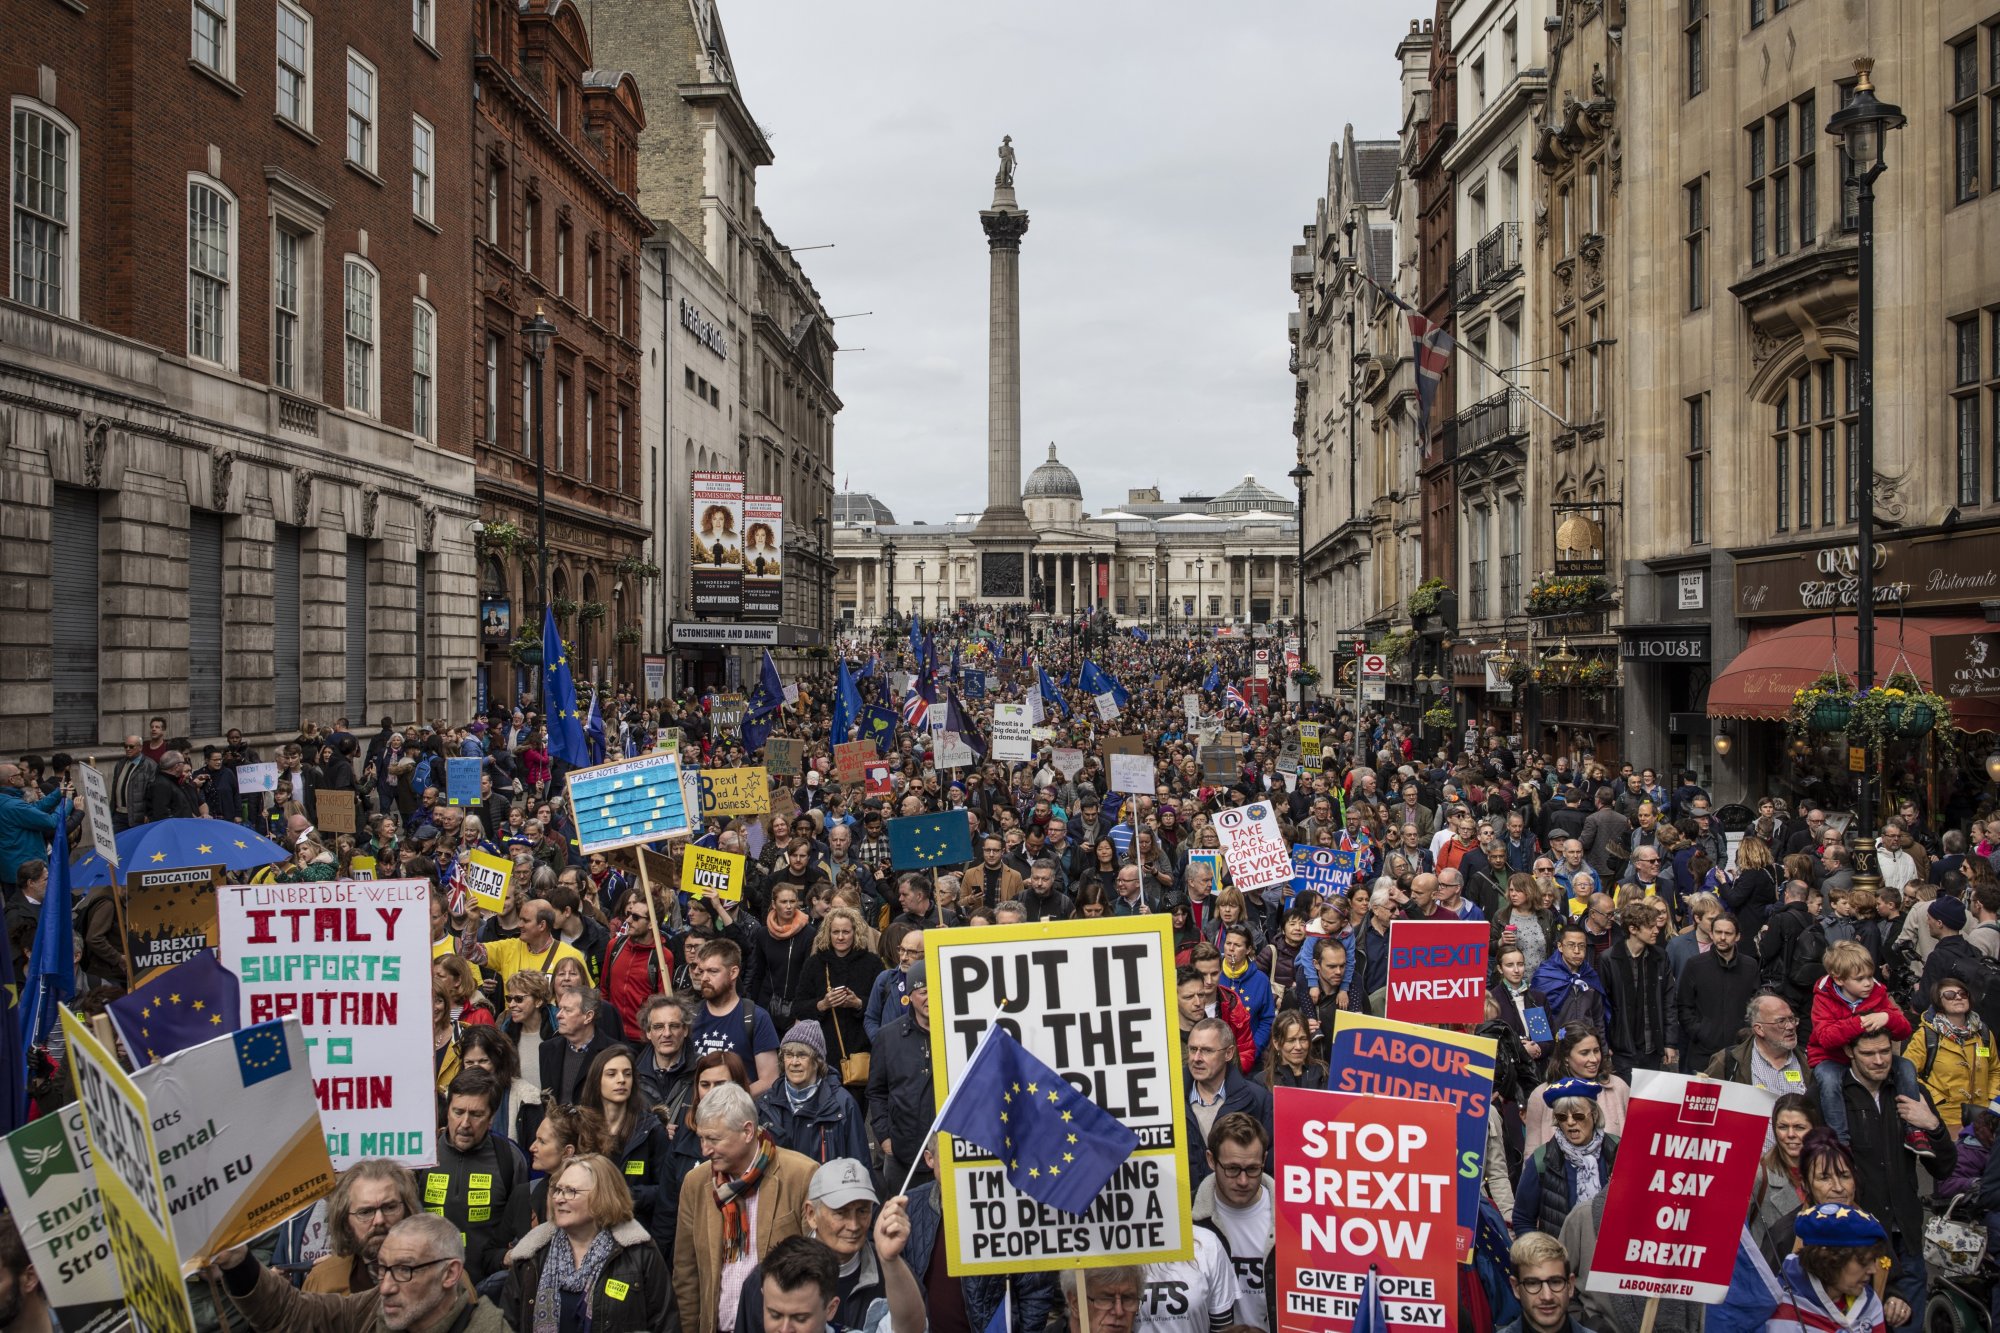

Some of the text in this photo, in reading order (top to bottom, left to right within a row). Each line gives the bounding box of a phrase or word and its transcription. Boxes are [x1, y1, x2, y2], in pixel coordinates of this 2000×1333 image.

[1570, 563, 1581, 571] Old
[1690, 577, 1701, 585] LET
[1925, 569, 1998, 592] Ristorante
[696, 596, 740, 604] SCARY BIKERS
[728, 629, 742, 638] AND
[1639, 640, 1701, 657] HOUSE
[712, 711, 741, 724] WANT
[658, 730, 667, 739] UK
[572, 755, 670, 783] TAKE NOTE MRS MAY!
[1303, 755, 1321, 768] VOTE
[732, 786, 739, 797] 4
[1229, 823, 1263, 841] TAKE
[1232, 836, 1267, 851] BACK
[697, 853, 732, 866] WE DEMAND
[1228, 838, 1284, 864] CONTROL?
[1229, 851, 1288, 877] REVOKE
[144, 870, 210, 885] EDUCATION
[470, 864, 504, 887] PUT IT TO
[694, 868, 729, 889] VOTE
[700, 863, 731, 873] PEOPLE'S
[1235, 865, 1291, 889] ARTICLE 50
[474, 881, 501, 897] PEOPLE
[246, 908, 403, 944] ITALY
[150, 935, 206, 953] BREXIT
[1392, 943, 1486, 969] BREXIT
[241, 955, 401, 983] SUPPORTS
[950, 944, 1148, 1016] PUT IT
[1391, 977, 1485, 1002] WREXIT
[250, 992, 398, 1026] BRITAIN
[1042, 1008, 1154, 1069] THE
[1353, 1032, 1471, 1077] LABOUR
[312, 1076, 393, 1111] MAIN
[1338, 1068, 1486, 1118] STUDENTS
[1685, 1094, 1717, 1105] LABOUR
[1688, 1103, 1716, 1112] SAY.EU
[1301, 1119, 1428, 1164] STOP
[1649, 1133, 1732, 1163] I WANT
[223, 1154, 254, 1184] EU
[968, 1170, 1005, 1200] I'M
[1283, 1165, 1450, 1213] BREXIT
[1648, 1169, 1715, 1197] A SAY
[168, 1176, 220, 1217] with
[247, 1173, 328, 1220] DEMAND BETTER
[970, 1190, 1164, 1231] TO DEMAND A
[1655, 1206, 1691, 1231] ON
[972, 1222, 1166, 1259] PEOPLES VOTE
[1301, 1213, 1432, 1260] NOW
[1625, 1239, 1707, 1269] BREXIT
[1231, 1256, 1265, 1290] FS
[1298, 1270, 1433, 1298] GIVE POPLE
[1618, 1278, 1694, 1296] LABOURSAY.EU
[1288, 1294, 1443, 1325] THE FINL SAY
